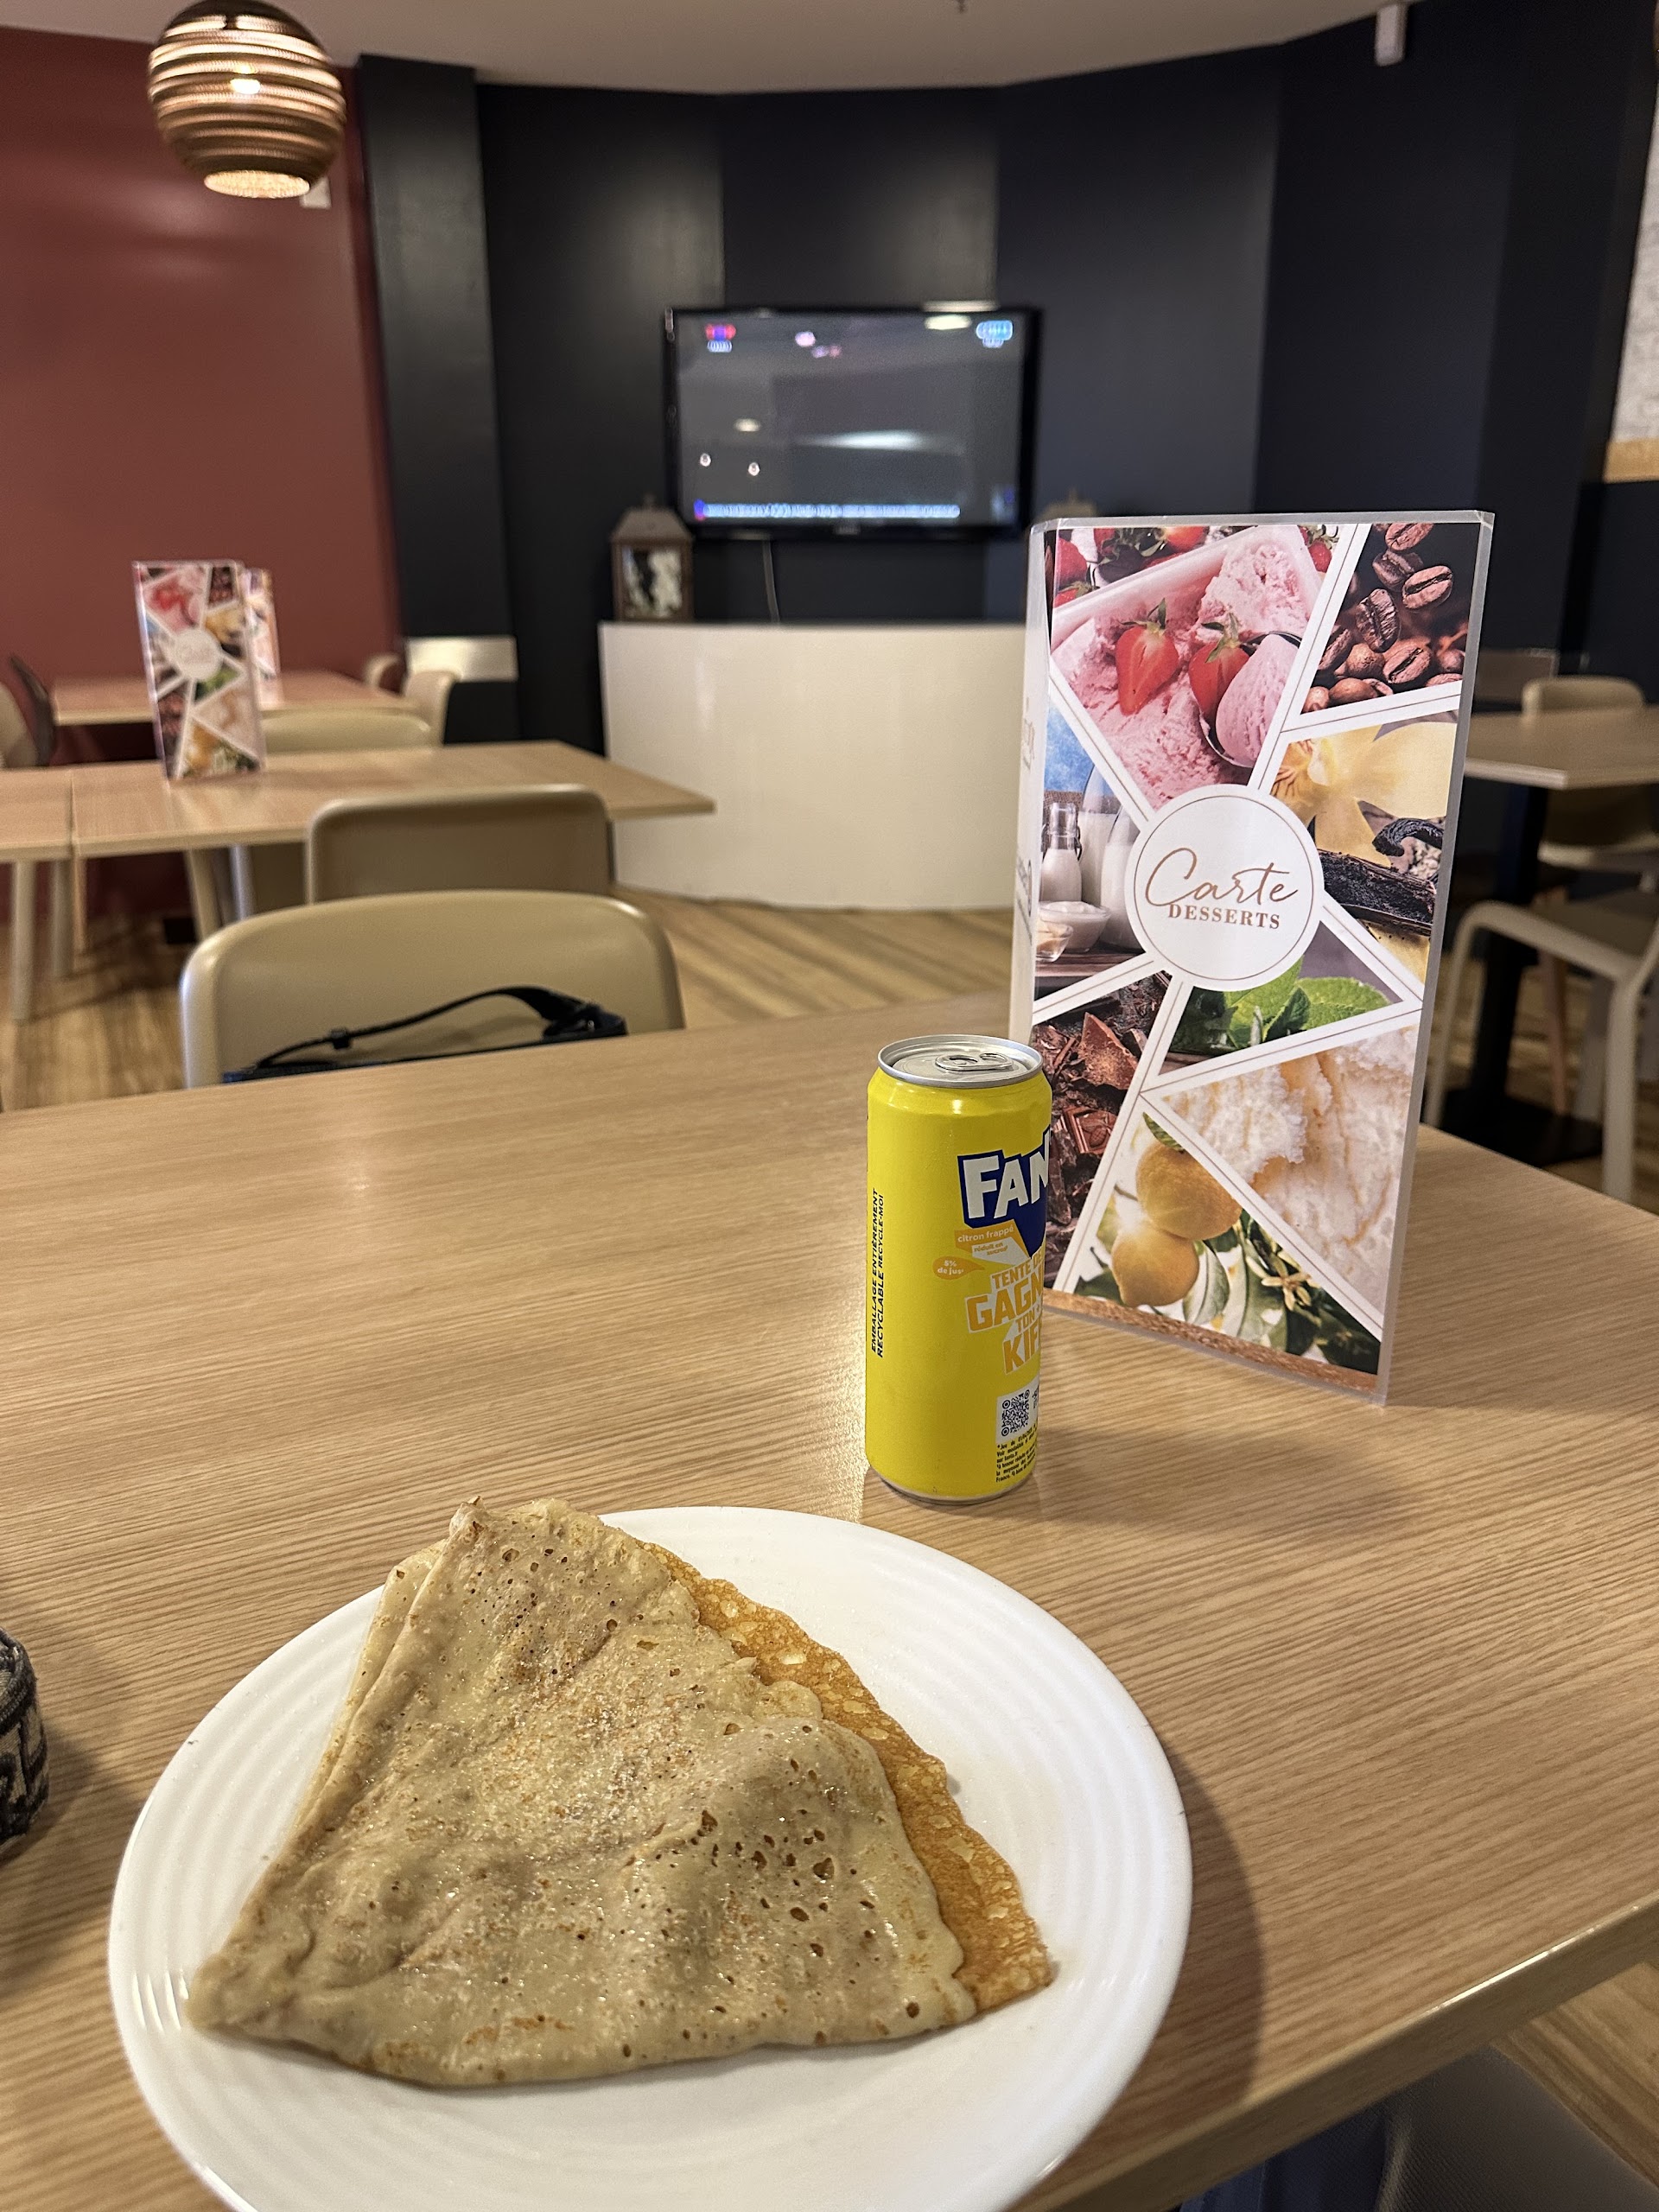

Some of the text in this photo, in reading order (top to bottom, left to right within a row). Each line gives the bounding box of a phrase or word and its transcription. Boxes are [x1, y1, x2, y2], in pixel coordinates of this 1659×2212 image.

[1145, 848, 1299, 906] Carte
[1167, 903, 1280, 930] DESSERTS
[957, 1224, 1014, 1243] citron frappé
[991, 1262, 1031, 1289] TENTE
[966, 1266, 1043, 1332] GAGN
[1003, 1319, 1040, 1374] KIF
